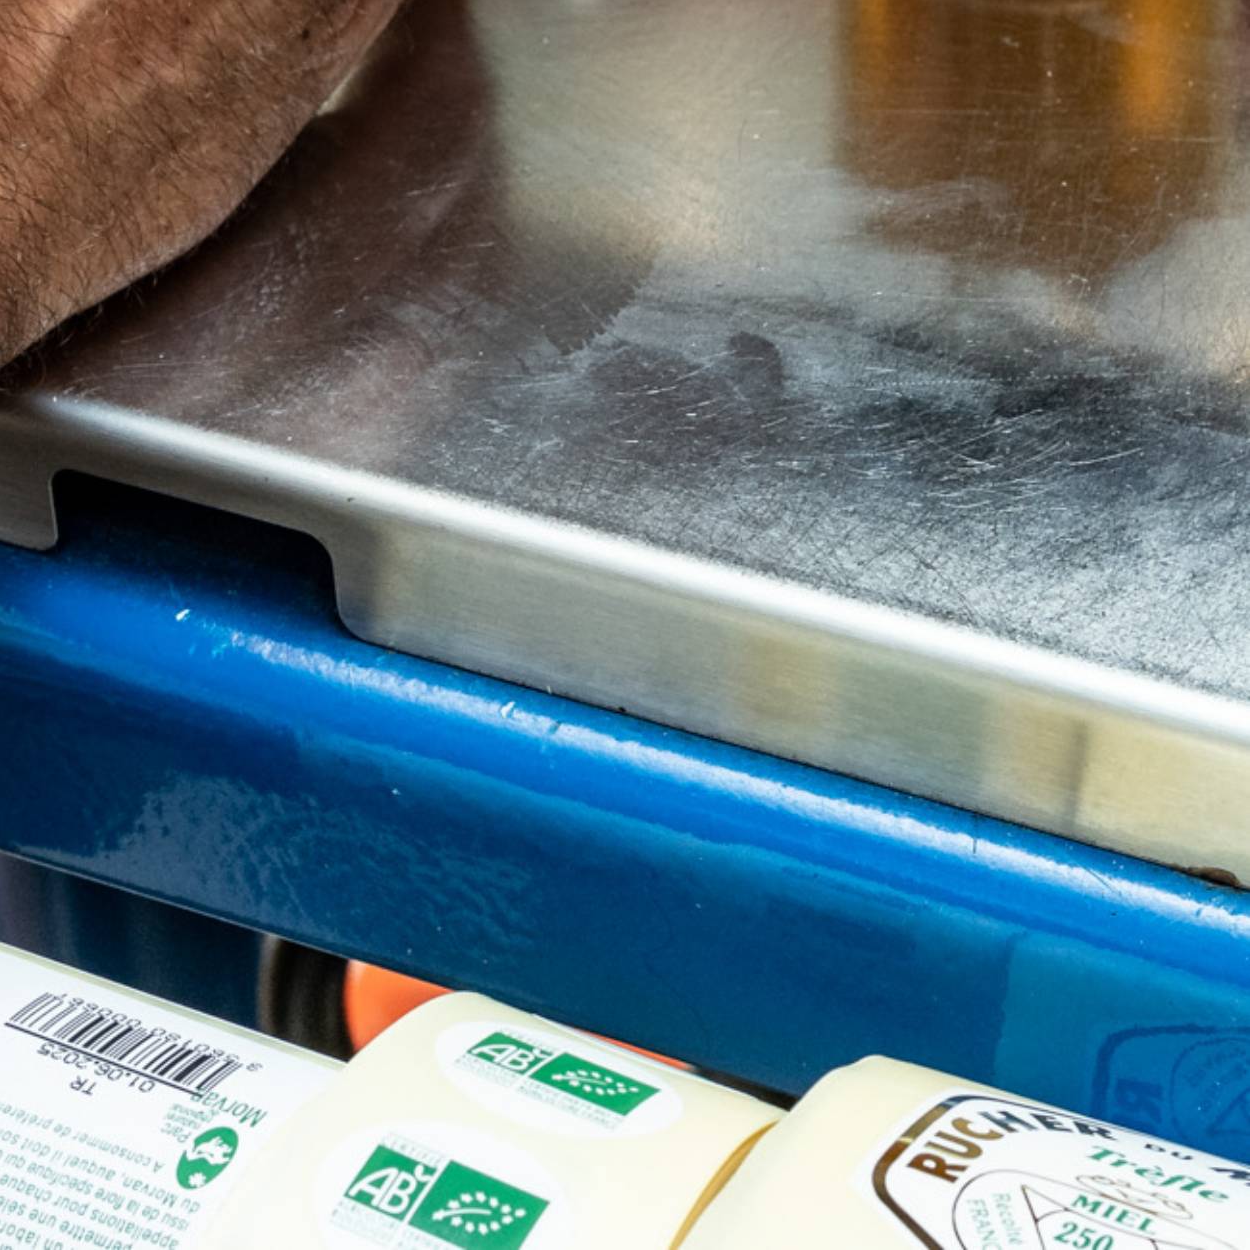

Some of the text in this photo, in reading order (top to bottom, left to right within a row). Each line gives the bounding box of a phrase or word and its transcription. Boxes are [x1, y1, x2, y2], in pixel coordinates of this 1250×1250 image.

[37, 1040, 155, 1094] 01.06.2025
[470, 1043, 535, 1071] AB
[69, 1075, 97, 1096] TR
[190, 1088, 267, 1127] Morvan
[54, 1124, 71, 1137] de
[21, 1139, 50, 1156] doit
[51, 1148, 63, 1161] il
[73, 1134, 151, 1166] consommer
[907, 1110, 1117, 1183] RUCHER
[5, 1154, 26, 1168] qui
[63, 1156, 116, 1181] auquel
[1087, 1145, 1229, 1203] Trèfle
[0, 1174, 52, 1202] chaque
[94, 1188, 126, 1210] flore
[123, 1174, 178, 1208] Morvan,
[348, 1167, 417, 1214] AB
[28, 1209, 57, 1227] une
[53, 1196, 90, 1216] pour
[126, 1200, 141, 1215] la
[142, 1206, 160, 1221] de
[181, 1198, 200, 1214] du
[1072, 1194, 1157, 1235] MIEL
[90, 1209, 179, 1250] appellations
[161, 1213, 189, 1230] issu
[966, 1198, 1002, 1250] FRANC
[1054, 1221, 1114, 1250] 250
